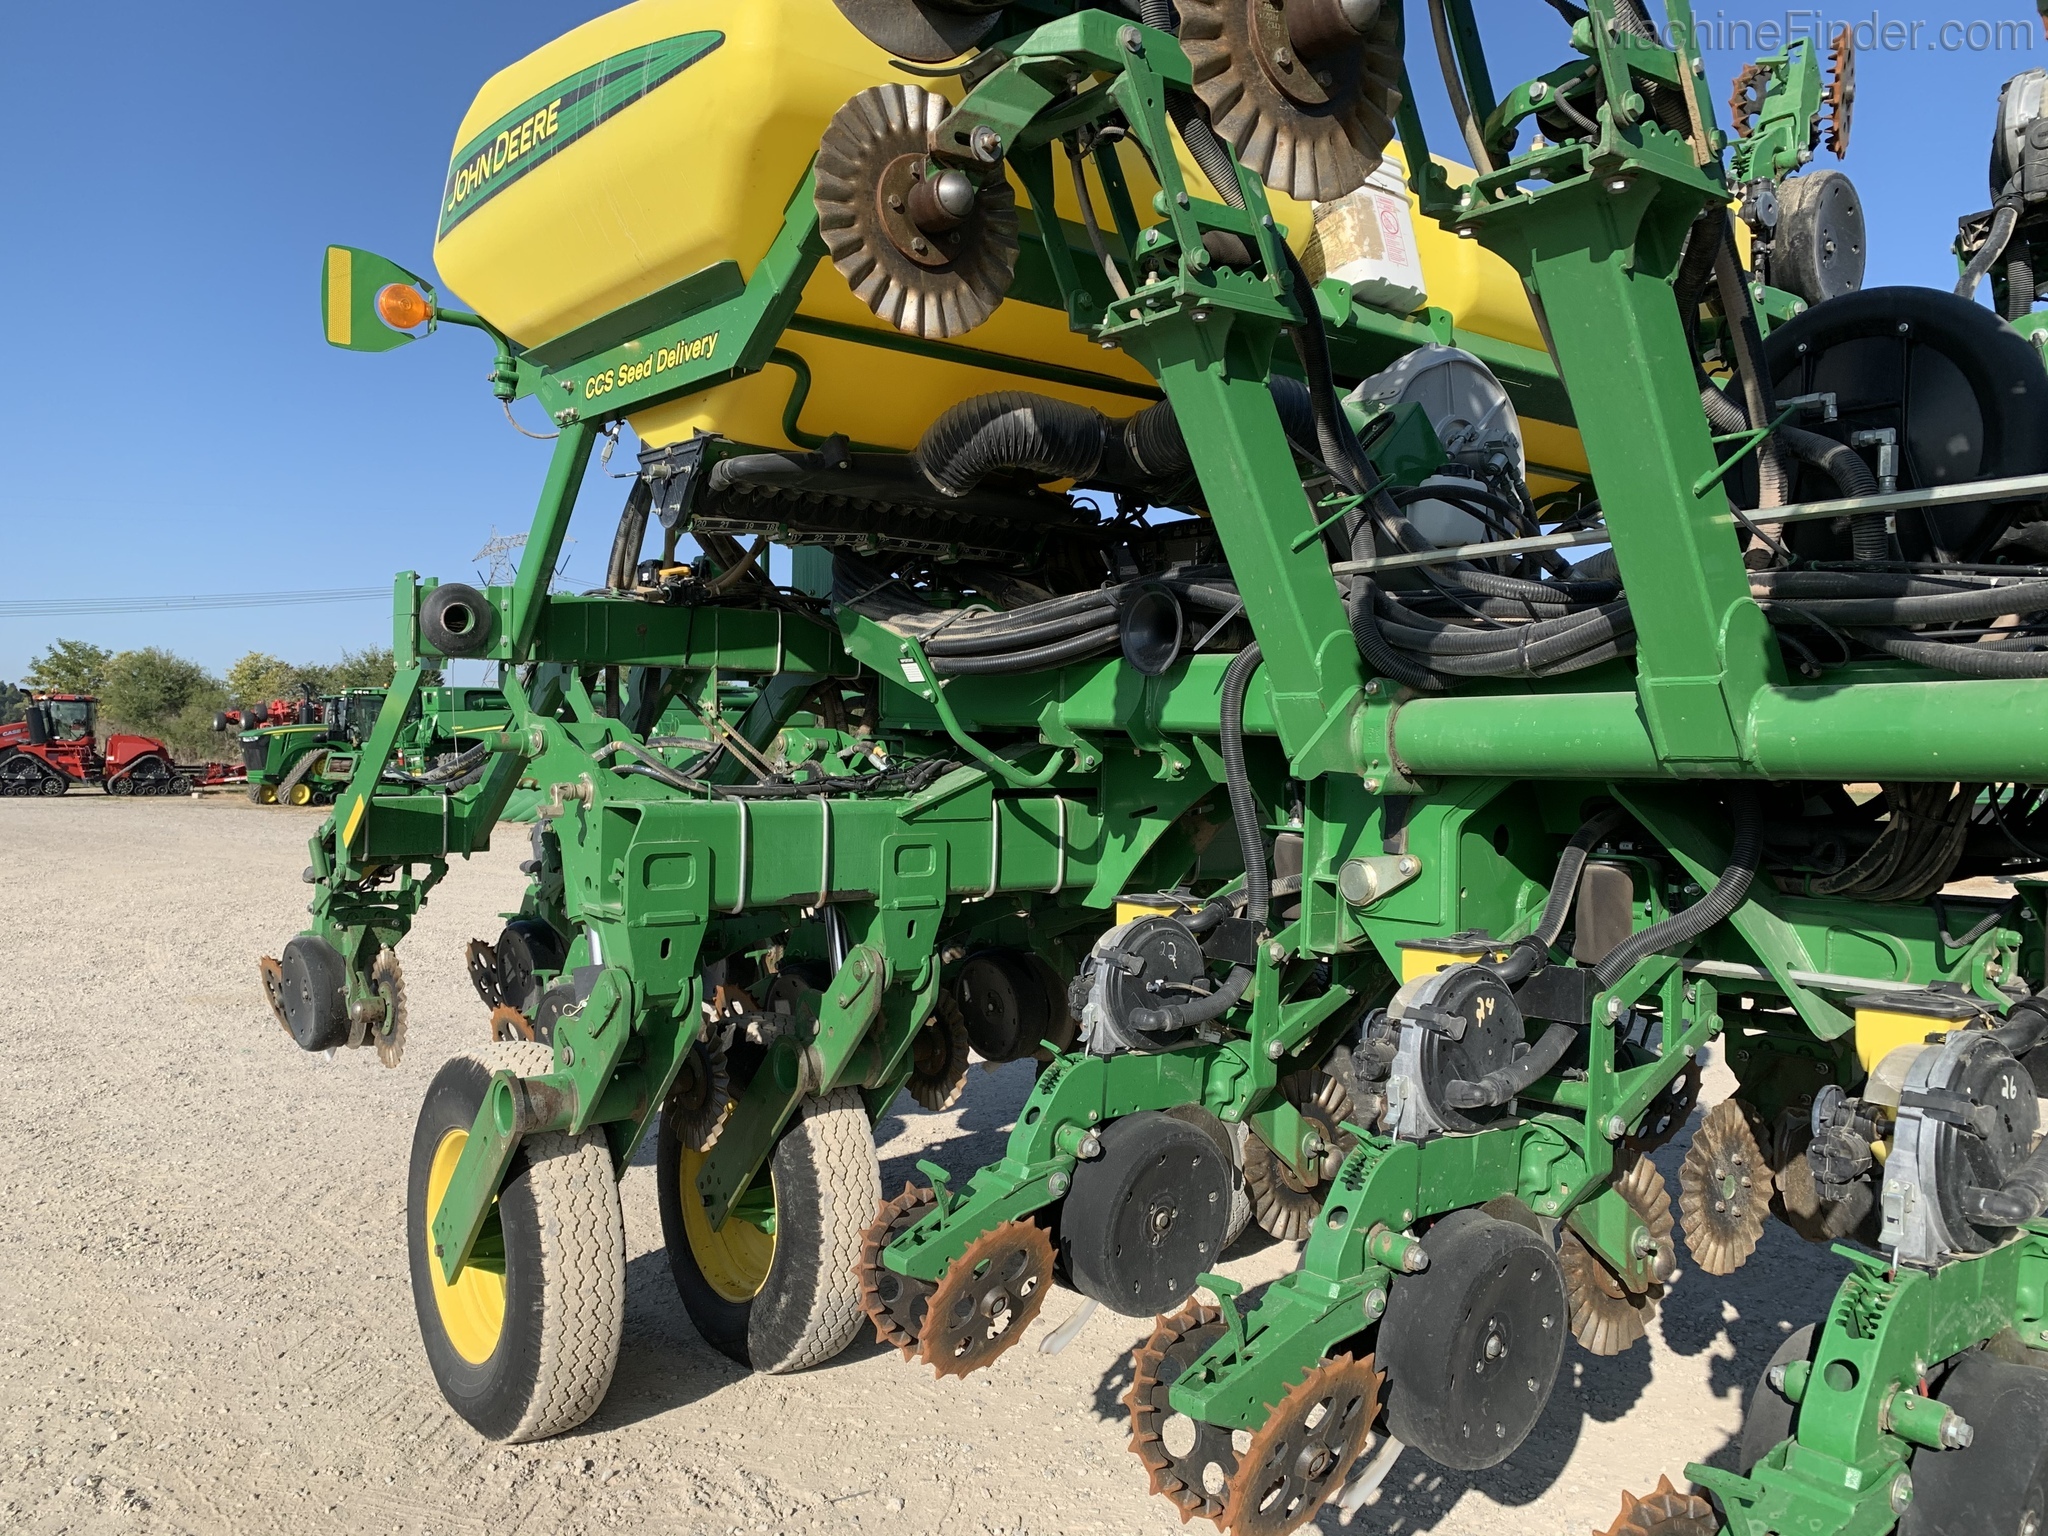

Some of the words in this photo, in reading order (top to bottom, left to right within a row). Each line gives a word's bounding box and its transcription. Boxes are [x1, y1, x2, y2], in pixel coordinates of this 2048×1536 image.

[447, 147, 493, 212] JOHN
[493, 98, 562, 174] DEERE
[585, 369, 615, 400] CCS
[617, 352, 654, 388] Seed
[656, 331, 720, 374] Delivery
[697, 520, 707, 528] 20
[720, 520, 730, 528] 21
[744, 522, 755, 530] 19
[1476, 996, 1495, 1028] 24
[2001, 1074, 2018, 1100] 26
